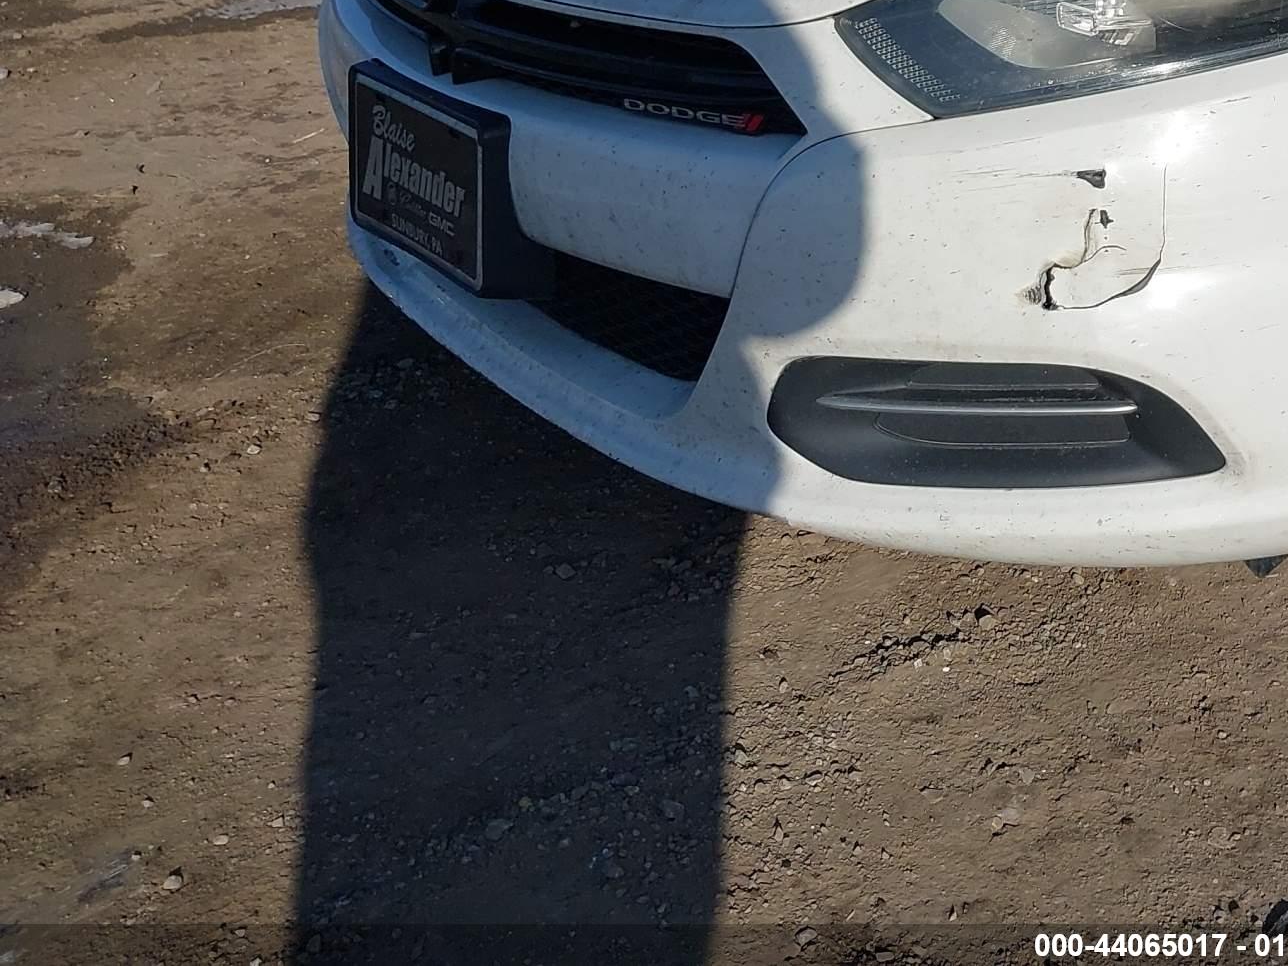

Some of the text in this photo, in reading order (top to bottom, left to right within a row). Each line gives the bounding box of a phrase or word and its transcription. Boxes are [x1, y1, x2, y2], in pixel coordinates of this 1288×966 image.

[372, 105, 416, 152] Blaise
[623, 98, 746, 127] DODGE
[362, 136, 467, 218] Alexander
[429, 212, 455, 236] GMC
